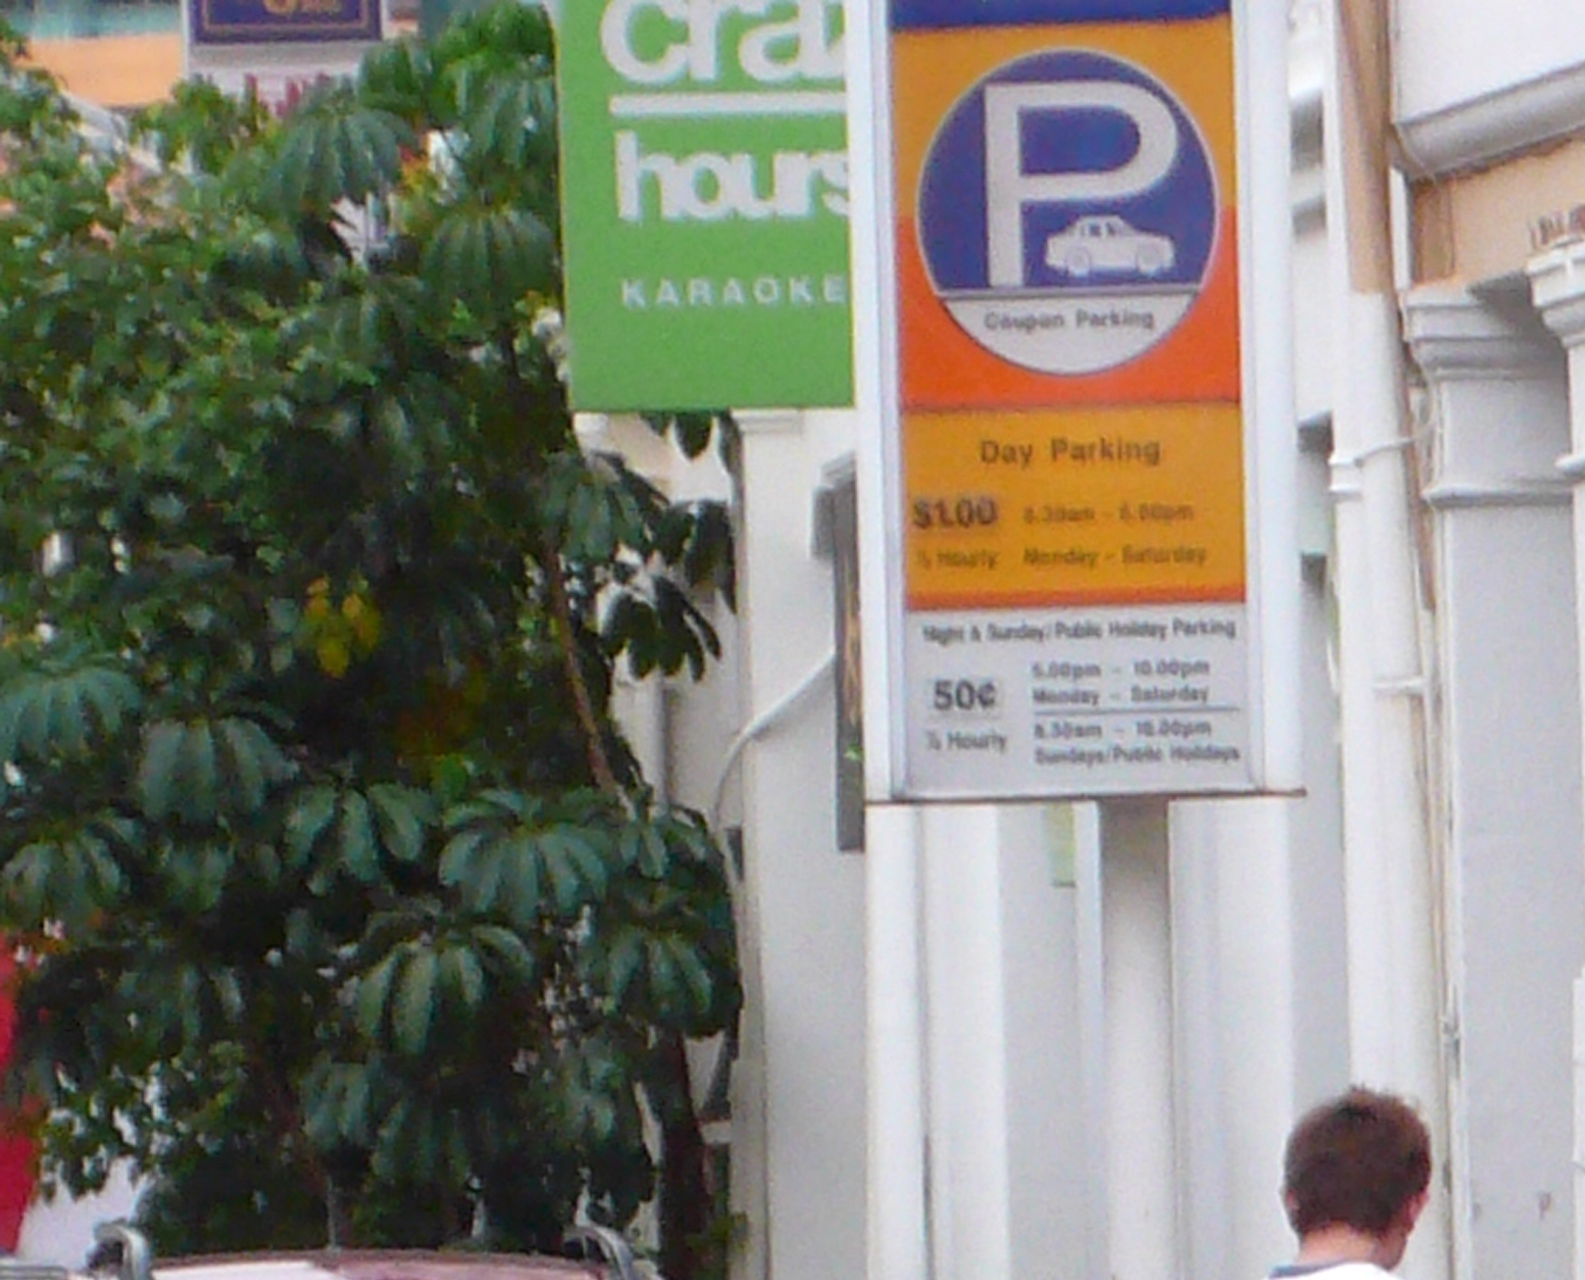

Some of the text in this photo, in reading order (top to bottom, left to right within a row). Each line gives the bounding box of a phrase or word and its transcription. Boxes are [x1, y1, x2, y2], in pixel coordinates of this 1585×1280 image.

[600, 0, 847, 82] cra
[614, 130, 850, 220] hours
[984, 81, 1178, 287] P
[622, 275, 846, 307] KARAOKE
[984, 307, 1155, 333] Coupon Parking
[980, 437, 1161, 469] Day Parking
[1024, 547, 1099, 568] Monday
[1122, 545, 1206, 566] Saturday
[1110, 620, 1166, 640] Holiday
[1173, 616, 1236, 639] Parking
[1032, 687, 1099, 704] Monday
[1131, 685, 1208, 702] Saturday
[947, 731, 1007, 752] Hourly
[1170, 744, 1240, 762] Holidays
